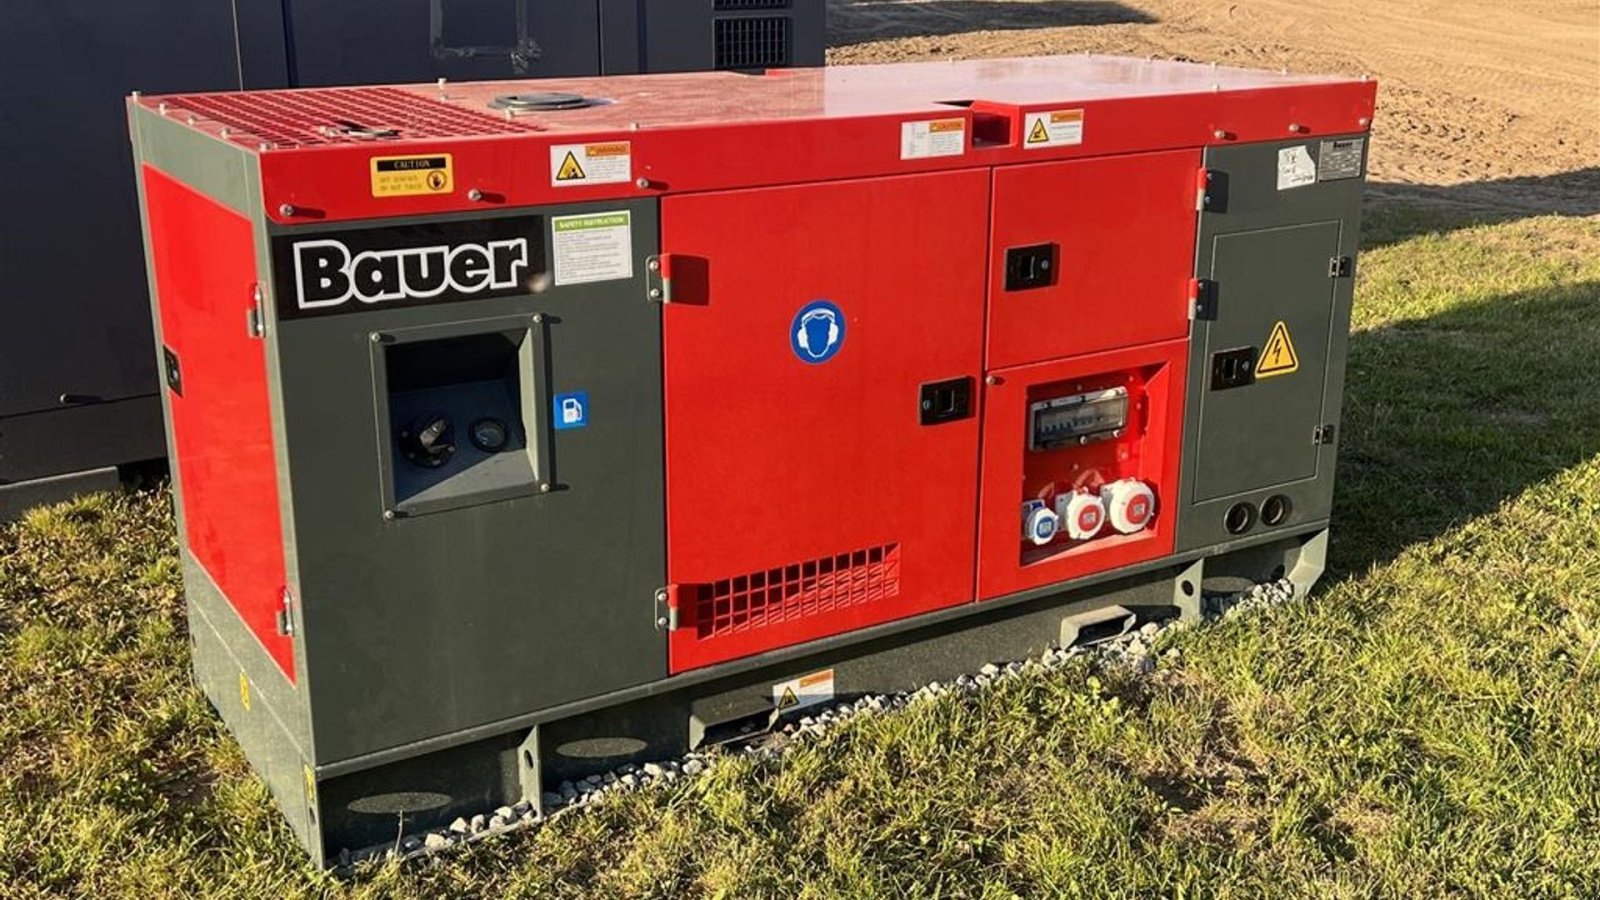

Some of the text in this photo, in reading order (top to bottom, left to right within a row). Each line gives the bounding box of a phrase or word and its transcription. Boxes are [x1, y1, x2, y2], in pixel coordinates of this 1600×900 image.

[393, 160, 430, 169] CAUTION
[559, 215, 625, 228] SAFETY INSTRUCTION
[293, 238, 528, 309] Bauer
